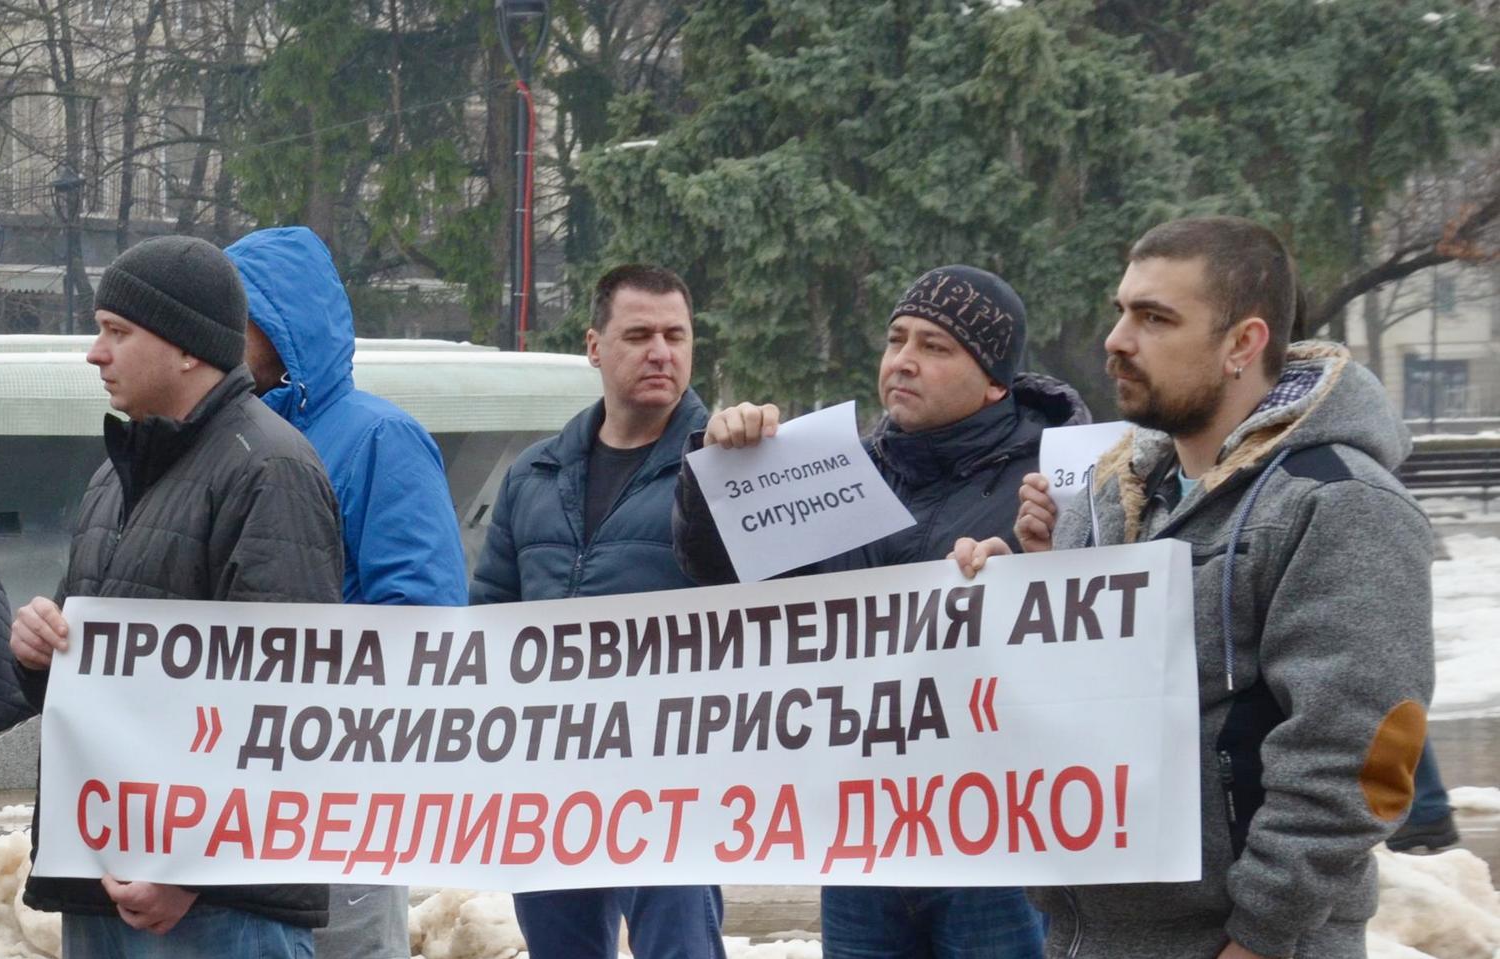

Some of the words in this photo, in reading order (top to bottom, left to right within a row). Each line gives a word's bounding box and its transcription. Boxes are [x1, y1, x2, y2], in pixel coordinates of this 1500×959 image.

[724, 480, 754, 499] За
[757, 453, 851, 489] по-голяма
[741, 482, 866, 532] сигурност
[1053, 468, 1075, 488] За
[77, 621, 386, 686] ПРОМЯНА
[407, 630, 487, 687] НА
[508, 583, 986, 684] ОБВИНИТЕЛНИЯ
[1007, 571, 1150, 645] АКТ
[236, 700, 632, 771] ДОЖИВОТНА
[652, 677, 950, 757] ПРИСЪДА
[76, 778, 699, 875] СПРАВЕДЛИВОСТ
[714, 783, 805, 862] ЗА
[820, 764, 1130, 874] ДЖОКО!
